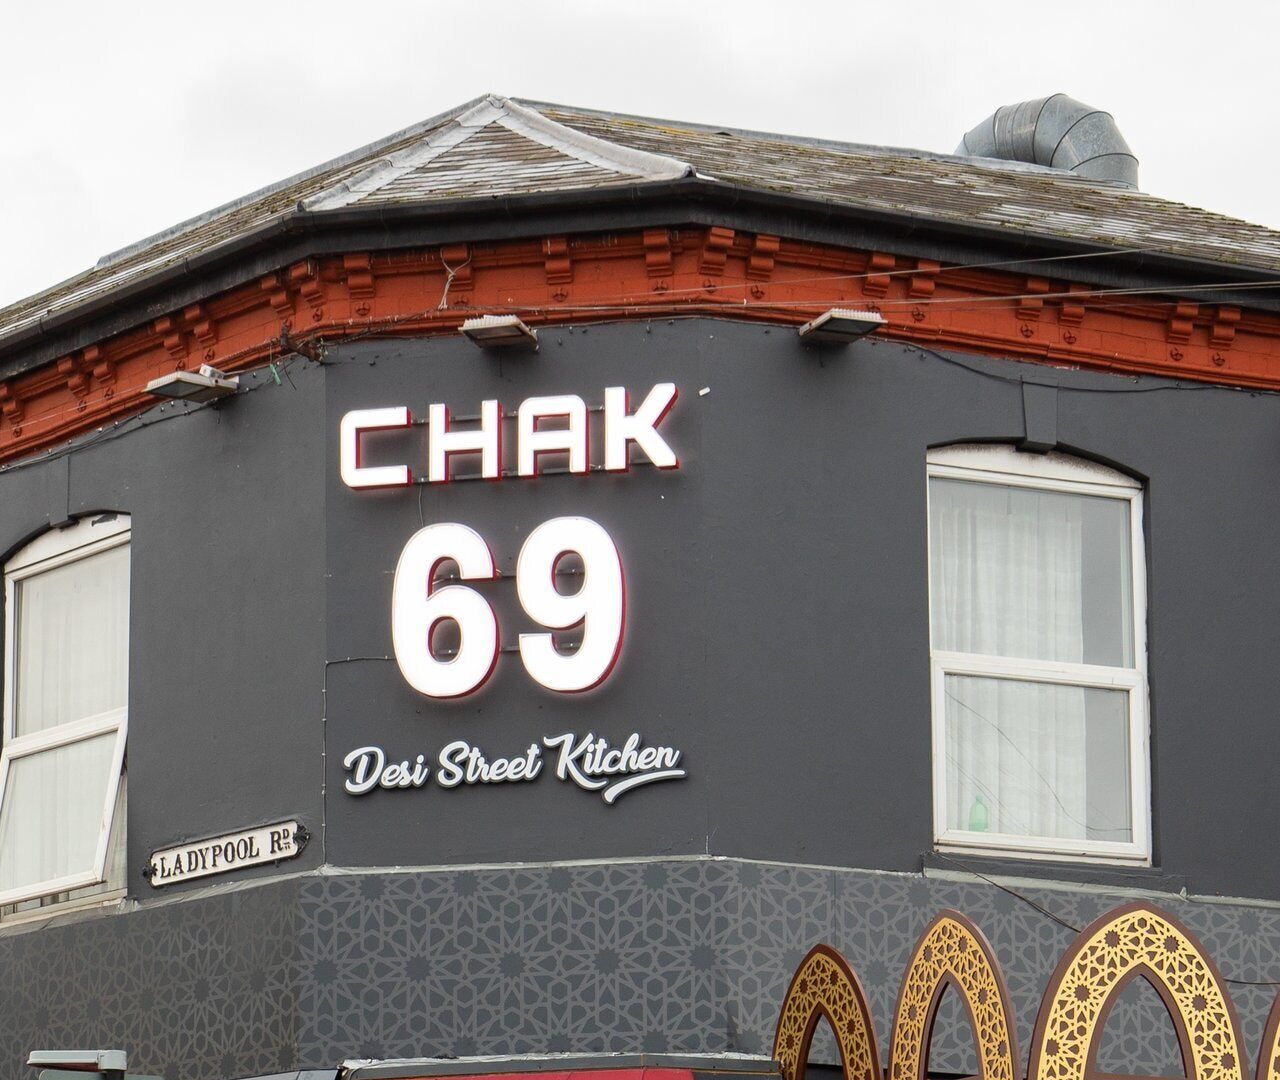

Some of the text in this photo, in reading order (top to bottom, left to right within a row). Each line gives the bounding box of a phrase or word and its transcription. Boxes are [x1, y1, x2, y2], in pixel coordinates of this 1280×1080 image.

[339, 382, 679, 490] CHAK
[392, 516, 627, 699] 69
[343, 732, 686, 804] Desi Street Kitchen
[160, 836, 260, 879] LADYPOOL
